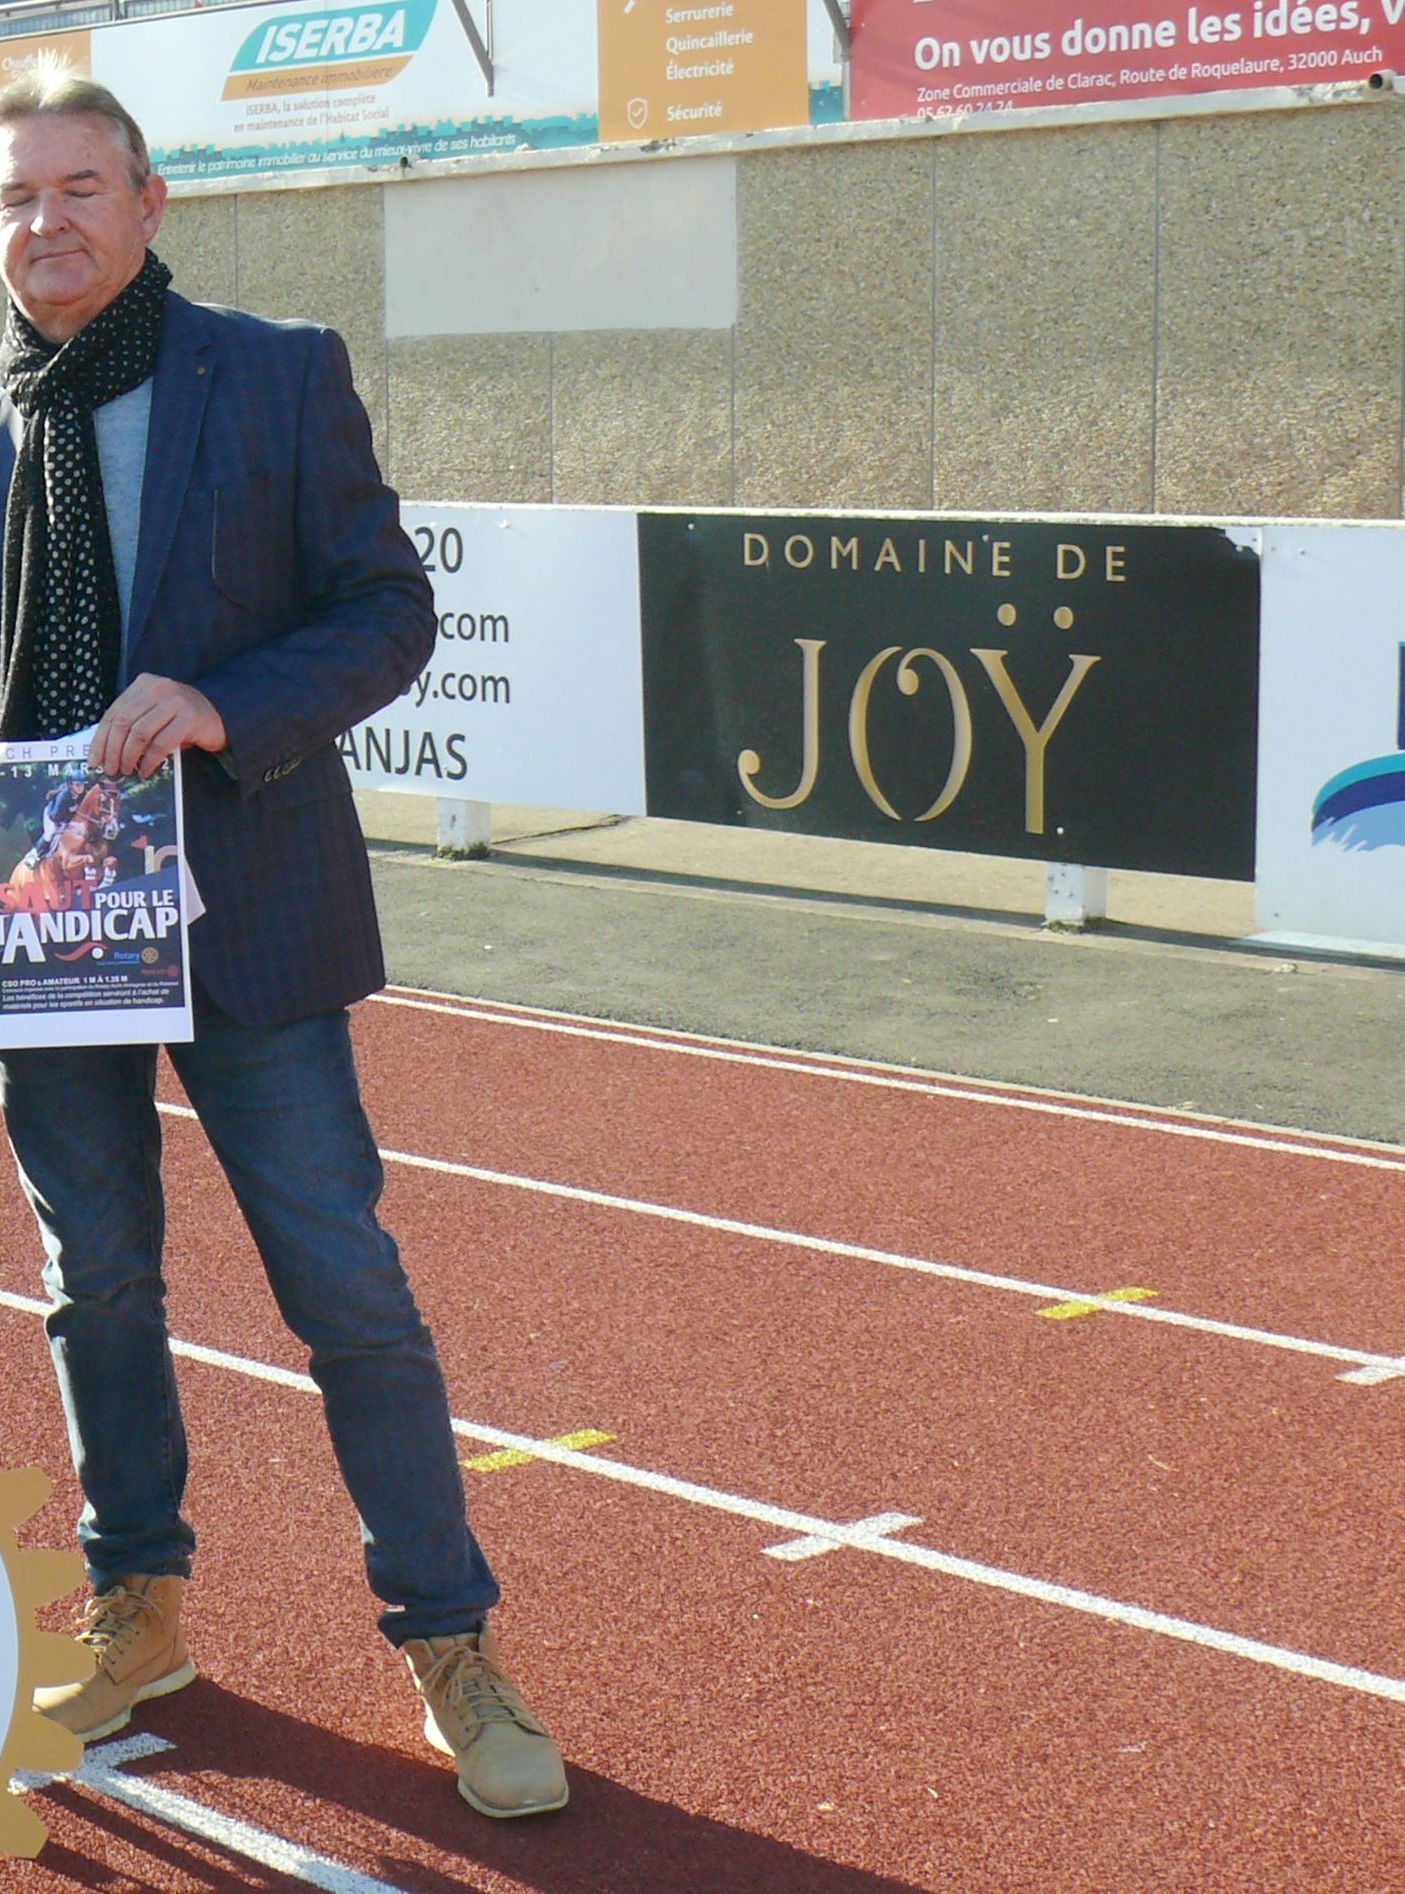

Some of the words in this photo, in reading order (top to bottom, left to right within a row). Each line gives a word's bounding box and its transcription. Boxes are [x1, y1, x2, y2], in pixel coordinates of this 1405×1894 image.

[666, 4, 734, 24] Serrurerie
[255, 9, 406, 64] ISERBA
[666, 28, 754, 55] Quincaillerie
[915, 37, 961, 70] On
[970, 32, 1051, 64] vous
[1061, 18, 1176, 56] donne
[1188, 7, 1241, 44] les
[1253, 0, 1370, 38] idées,
[245, 71, 319, 92] Maintenance
[666, 58, 734, 81] Électricité
[917, 87, 950, 102] Zone
[953, 75, 1042, 98] Commerciale
[1045, 75, 1063, 91] de
[1067, 72, 1116, 89] Clarac,
[1120, 69, 1165, 84] Route
[1169, 64, 1187, 80] de
[1192, 58, 1284, 79] Roquelaure,
[1288, 50, 1337, 69] 32000
[1341, 46, 1383, 64] Auch
[283, 100, 291, 112] la
[293, 98, 330, 111] solution
[667, 101, 723, 121] Sécurité
[234, 123, 245, 133] en
[246, 117, 305, 131] maintenance
[307, 115, 317, 126] de
[362, 107, 389, 121] Social
[198, 162, 206, 173] le
[308, 153, 320, 165] au
[322, 149, 358, 162] service
[360, 146, 373, 159] du
[434, 140, 447, 152] de
[449, 140, 467, 151] ses
[469, 134, 517, 149] habitants
[744, 532, 1011, 577] DOMAINE
[1056, 543, 1126, 582] DE
[440, 611, 509, 643] com
[399, 670, 510, 708] y.com
[50, 745, 91, 758] PRE
[340, 727, 468, 781] ANJAS
[95, 891, 146, 909] POUR
[152, 889, 174, 907] LE
